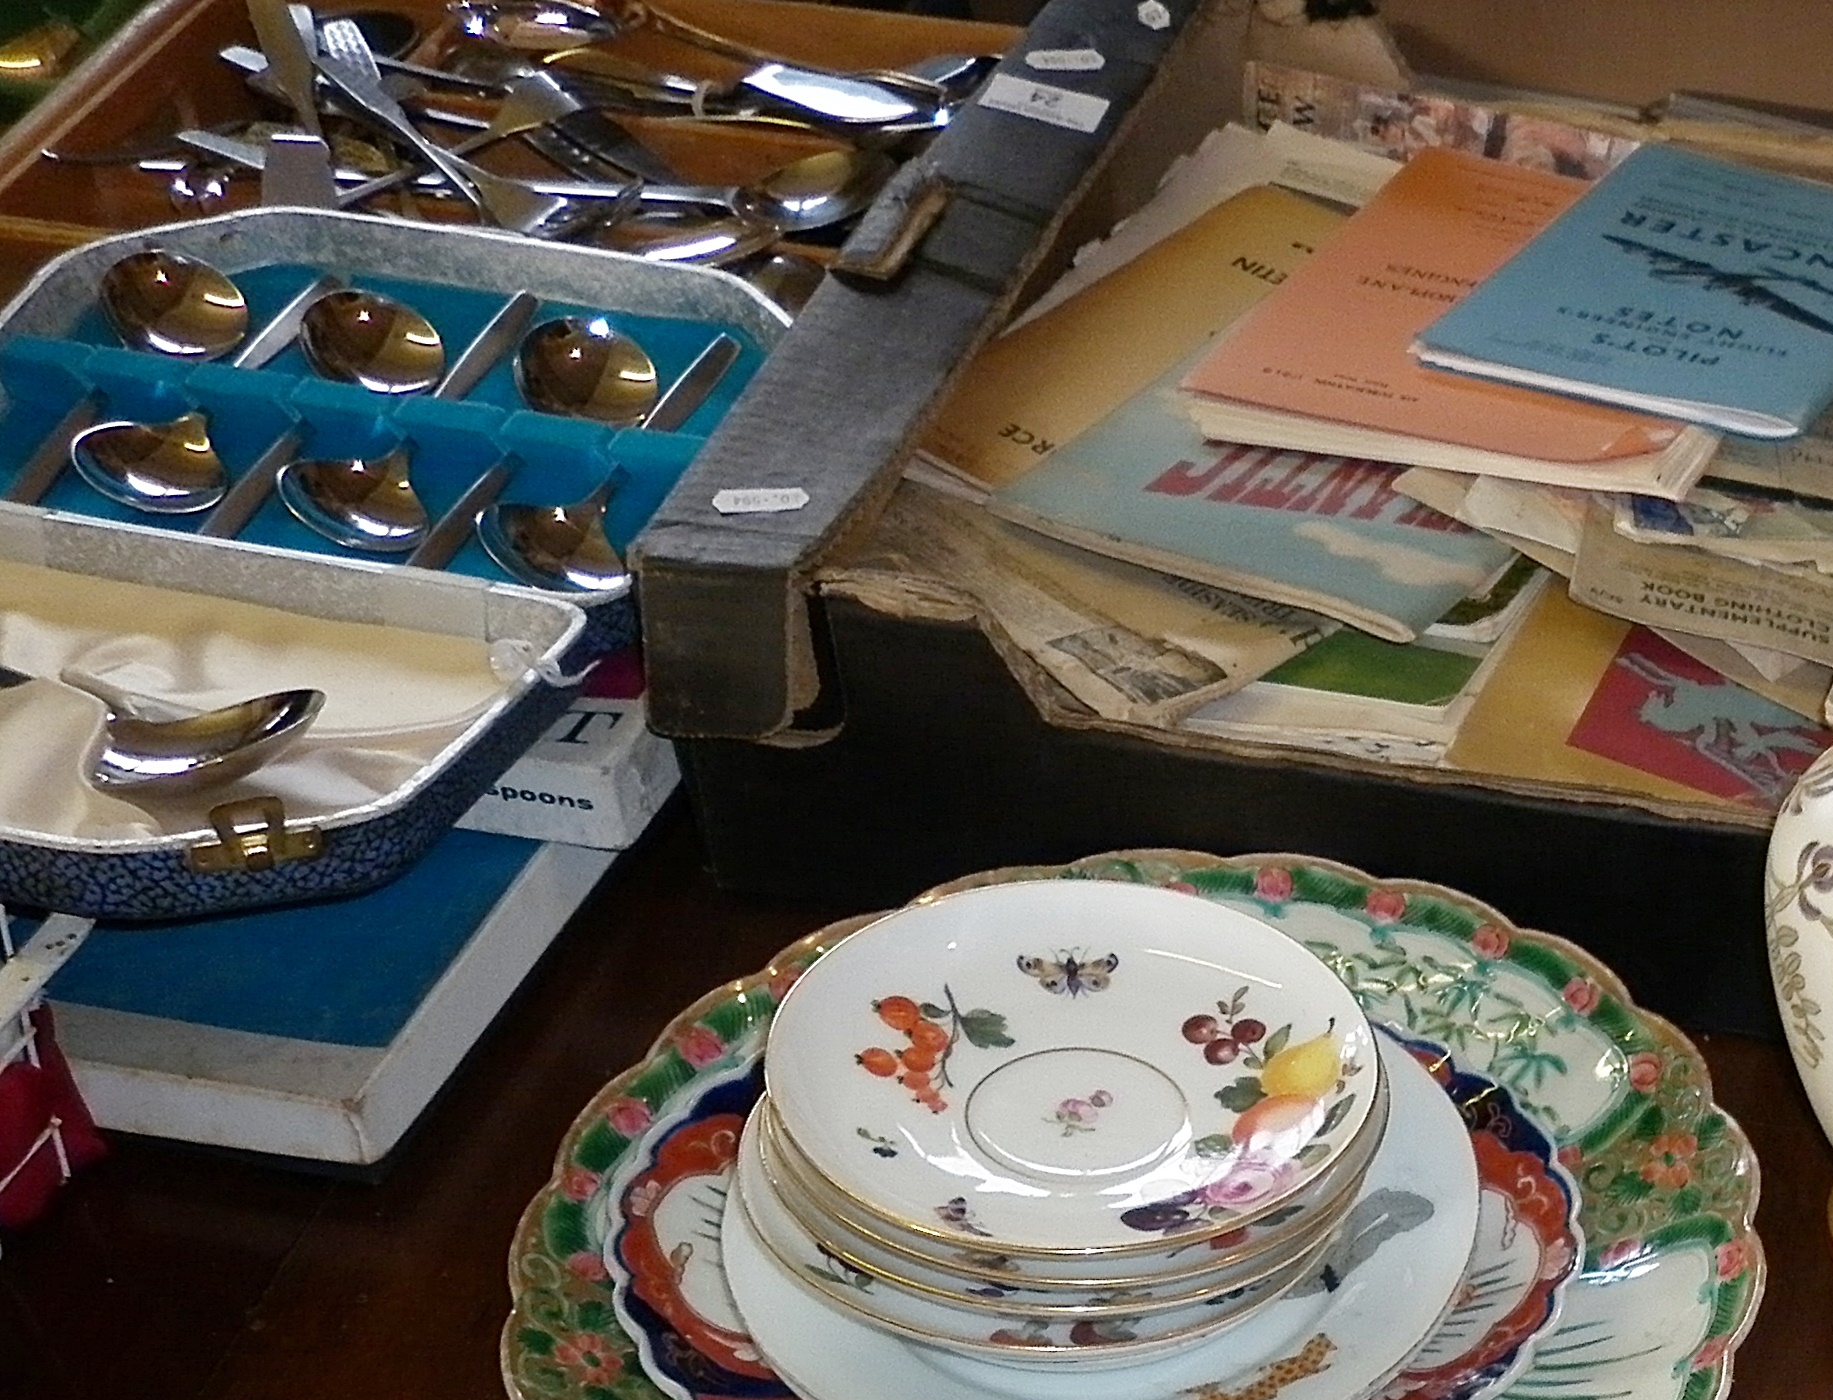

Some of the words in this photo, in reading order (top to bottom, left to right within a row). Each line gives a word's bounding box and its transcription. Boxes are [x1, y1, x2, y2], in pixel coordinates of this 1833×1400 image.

[1613, 306, 1744, 341] NOTES
[1590, 332, 1722, 366] PILOT'S
[1639, 580, 1706, 604] BOOK
[1639, 594, 1830, 645] SUPPLEMENTARY
[1714, 598, 1831, 634] CLOTHING
[554, 710, 624, 745] T
